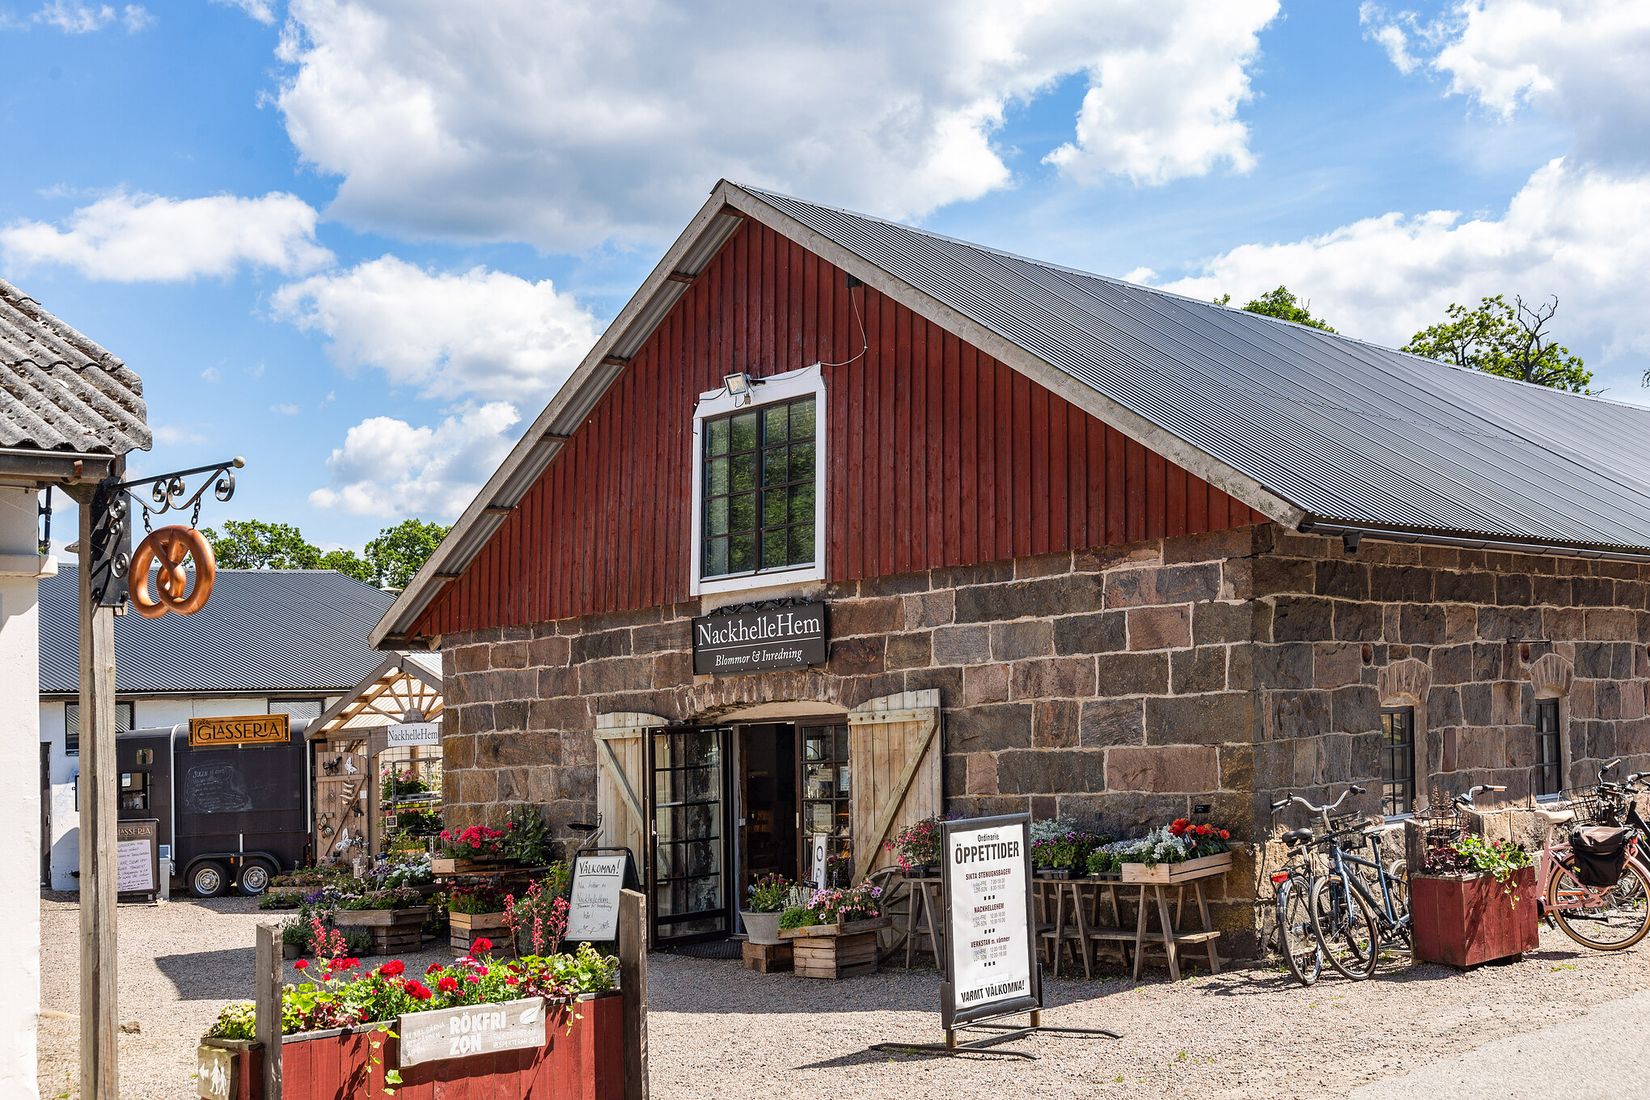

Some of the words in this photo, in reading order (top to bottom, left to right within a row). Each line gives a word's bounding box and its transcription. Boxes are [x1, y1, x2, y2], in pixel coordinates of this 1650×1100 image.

[698, 613, 821, 646] NackhelleHem
[715, 655, 750, 666] Blommor
[752, 651, 760, 662] &
[762, 648, 802, 661] Inredning
[198, 722, 280, 740] GLASSERIA
[388, 729, 438, 741] NackhelleHem
[978, 833, 999, 842] Ordinarie
[955, 841, 1019, 864] ÖPPETTIDER
[974, 903, 1004, 913] NACKHELLEHEM
[971, 939, 990, 948] VERKSTAN
[961, 989, 983, 1003] VARMT
[985, 980, 1025, 997] VÄLKOMNA!
[450, 1012, 507, 1034] RÖKFRI
[449, 1034, 482, 1055] ZON
